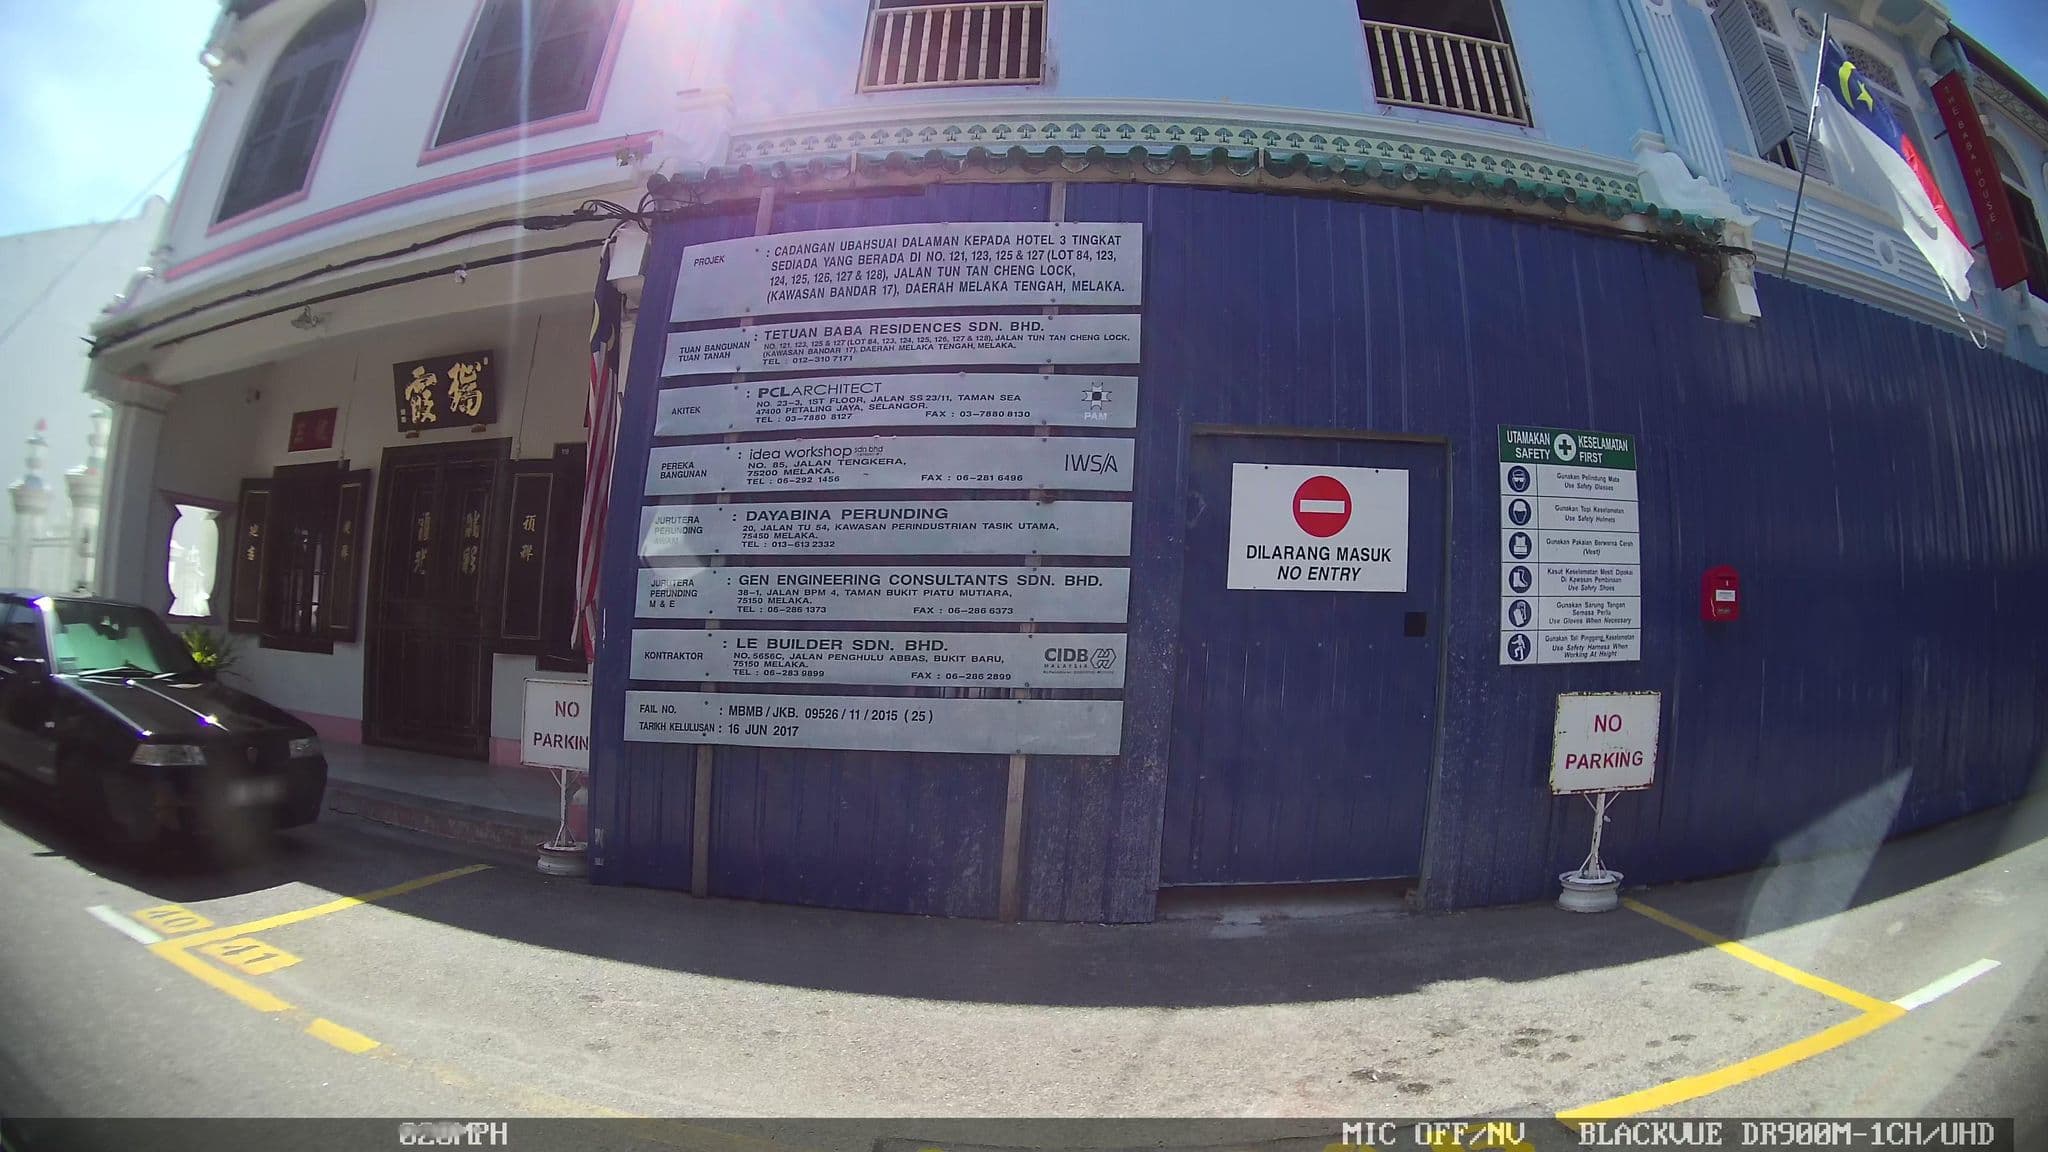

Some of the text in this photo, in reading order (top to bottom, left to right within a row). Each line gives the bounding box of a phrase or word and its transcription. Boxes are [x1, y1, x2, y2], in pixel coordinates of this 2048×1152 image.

[1944, 86, 1997, 223] THE BABA HOUSE
[774, 234, 1122, 256] CADANGAN UBAHSUAI DALAMAN KEPADA HOTEL 3 TINGKAT
[694, 256, 725, 266] PROJEK
[771, 250, 1116, 272] SEDIADA YANG BERADA DI NO. 121, 123, 125 & 127 (LOT 84, 123,
[770, 265, 1076, 286] 124, 125, 126, 127 & 128), JALAN TUN TAN CHENG LOCK,
[766, 280, 1124, 304] (KAWASAN BANDAR 17), DAERAH MELAKA TENGAH, MELAKA.
[764, 321, 1044, 340] TETUAN BABA RESIDENCES SDN. BHD.
[680, 341, 750, 354] TUAN BANGUNAN
[678, 352, 730, 362] TUAN TANAH
[672, 406, 700, 415] AKITEK
[1084, 412, 1107, 421] PAM
[1507, 430, 1550, 445] UTAMAKAN
[1578, 435, 1628, 452] KESELAMATAN
[750, 448, 781, 460] idea
[785, 447, 852, 460] workshop
[1515, 448, 1550, 460] SAFETY
[1579, 452, 1603, 464] FIRST
[661, 461, 694, 470] PEREKA
[838, 458, 907, 466] TENGKERA,
[660, 470, 707, 479] BANGUNAN
[655, 516, 700, 524] JURUTERA
[746, 508, 948, 522] DAYABINA PERUNDING
[655, 526, 703, 535] PERUNDING
[835, 523, 886, 531] KAWASAN
[892, 522, 976, 530] PERINDUSTRIAN
[1018, 522, 1059, 531] UTAMA,
[1247, 545, 1392, 562] DILARANG MASUK
[1278, 566, 1361, 581] NO ENTRY
[739, 574, 1102, 586] GEN ENGINEERING CONSULTANTS SDN. BHD.
[650, 590, 698, 598] PERUNDING
[737, 589, 761, 597] 38-1,
[830, 589, 839, 597] 4,
[886, 589, 918, 597] BUKIT
[923, 589, 954, 597] PIATU
[960, 589, 1012, 598] MUTIARA,
[650, 600, 675, 608] M & E
[736, 638, 948, 651] LE BUILDER SDN. BHD.
[644, 651, 703, 660] KONTRAKTOR
[734, 652, 750, 660] NO.
[753, 653, 784, 661] 5656C,
[827, 654, 884, 662] PENGHULU
[889, 655, 928, 663] ABBAS,
[934, 655, 966, 663] BUKIT
[1044, 648, 1089, 662] CIDB
[555, 700, 579, 718] NO
[640, 704, 676, 714] FAIL NO.
[728, 707, 763, 716] MBMB
[772, 708, 798, 718] JKB.
[805, 709, 838, 720] 09526
[850, 710, 860, 720] 11
[872, 710, 898, 721] 2015
[640, 722, 715, 732] TARIKH KELULUSAN
[1594, 714, 1622, 732] NO
[728, 724, 799, 736] 16 JUN 2017
[1565, 751, 1643, 770] PARKING
[222, 944, 280, 965] 41
